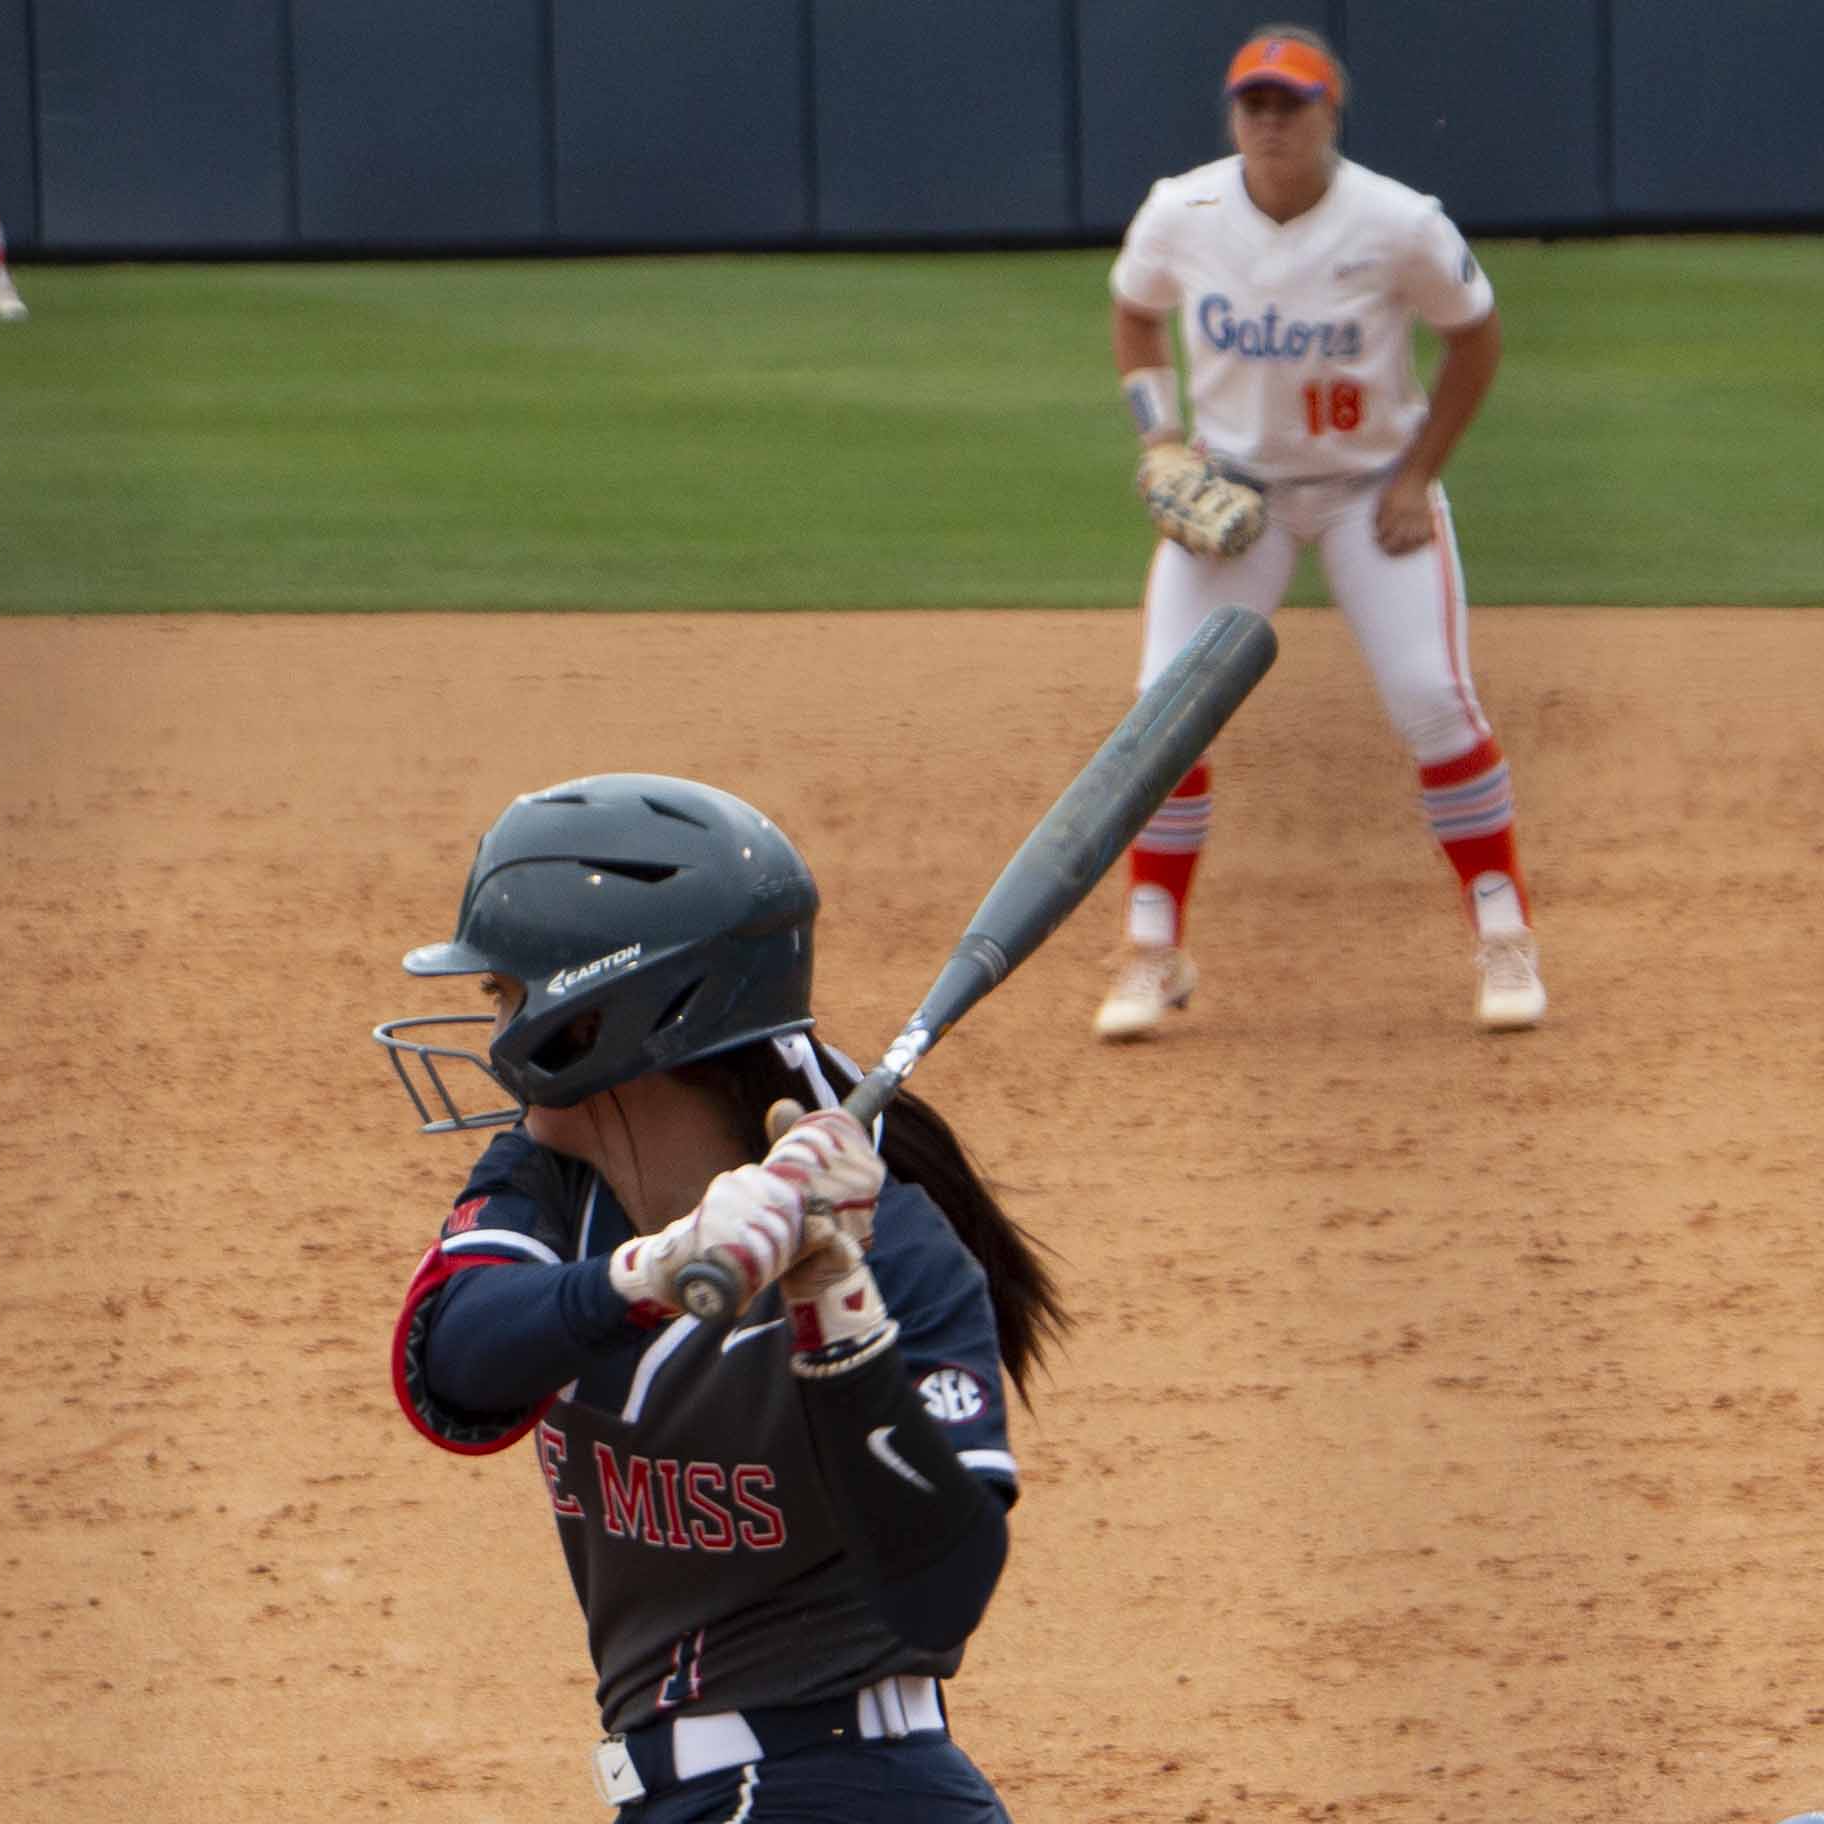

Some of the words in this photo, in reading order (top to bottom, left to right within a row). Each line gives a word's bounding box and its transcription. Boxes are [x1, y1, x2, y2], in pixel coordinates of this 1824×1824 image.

[1198, 293, 1362, 358] Gators
[1301, 378, 1364, 436] 18
[564, 942, 641, 987] EASTON
[918, 1368, 983, 1422] SEC
[593, 1440, 786, 1550] MISS
